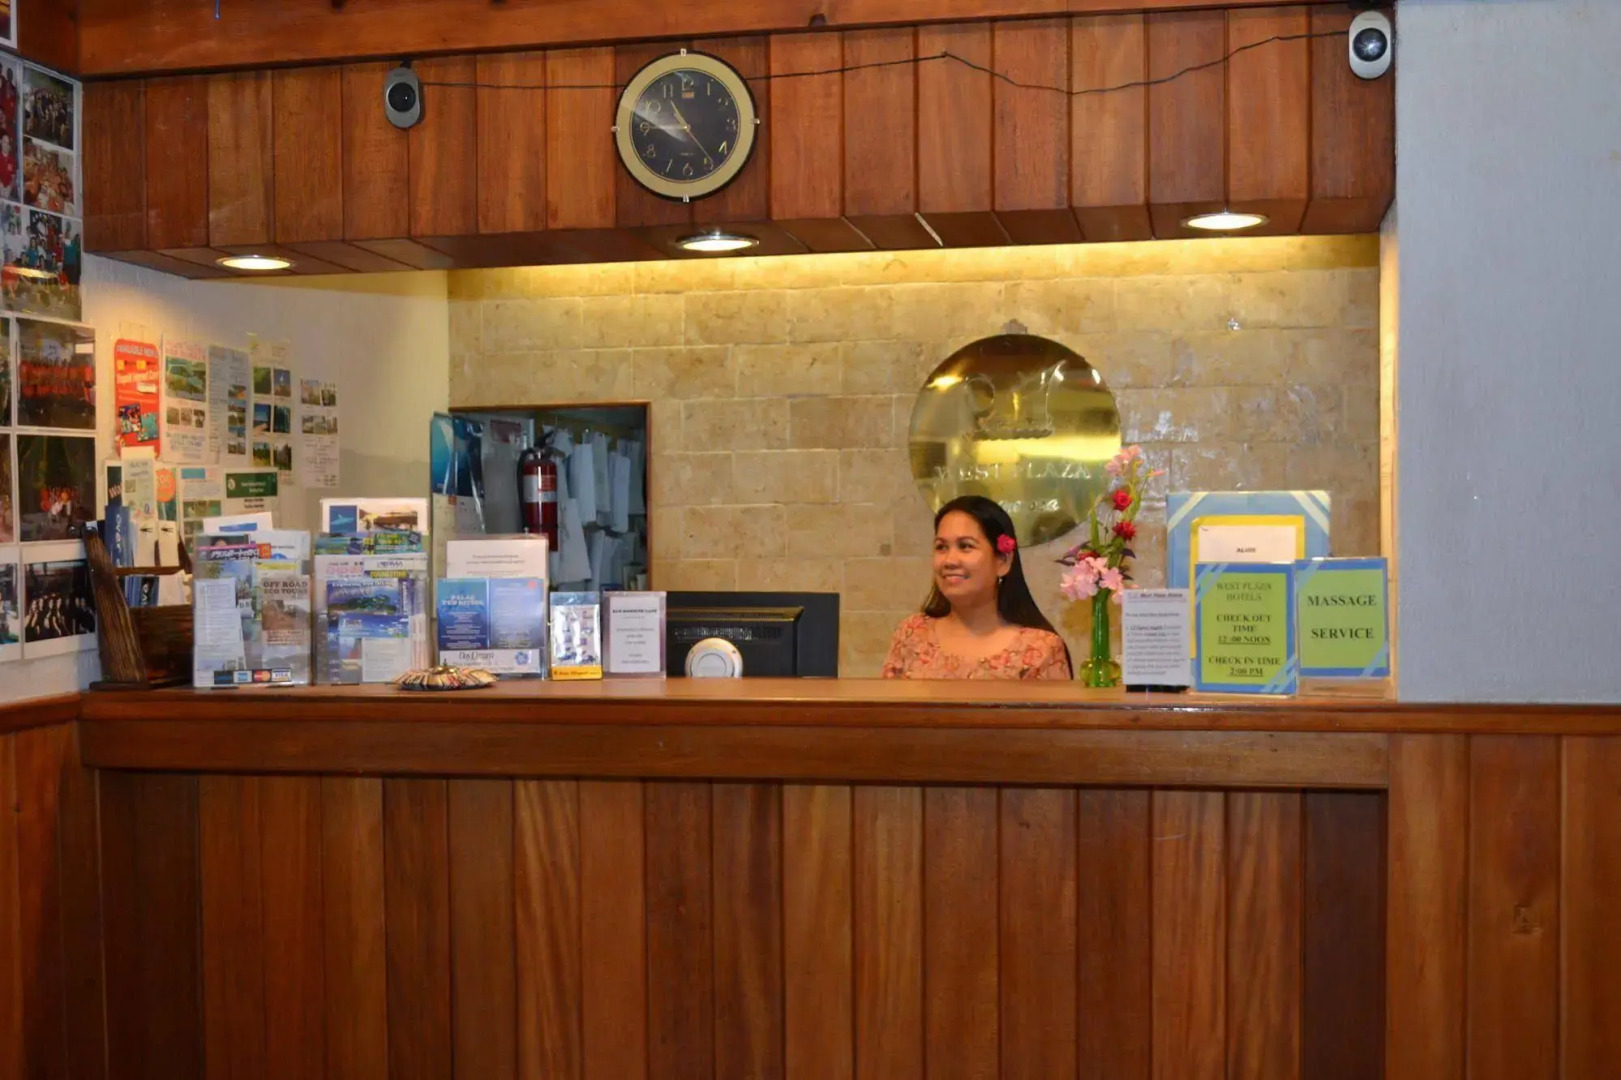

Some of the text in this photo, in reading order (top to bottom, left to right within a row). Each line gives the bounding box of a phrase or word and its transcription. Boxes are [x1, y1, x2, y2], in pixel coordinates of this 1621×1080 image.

[663, 83, 674, 98] 11
[645, 101, 662, 118] 10
[640, 122, 650, 136] 9
[646, 144, 656, 159] 8
[682, 162, 694, 176] 6
[1216, 583, 1272, 591] WEST PLAZA
[1226, 593, 1262, 601] HOTELS
[1307, 594, 1377, 607] MASSAGE
[1216, 614, 1272, 622] CHECK OUT
[1232, 624, 1256, 633] TIME
[1310, 627, 1375, 640] SERVICE
[1243, 635, 1271, 643] NOON
[1208, 656, 1281, 666] CHECK IN TIME
[1230, 667, 1264, 675] 2:00 PM
